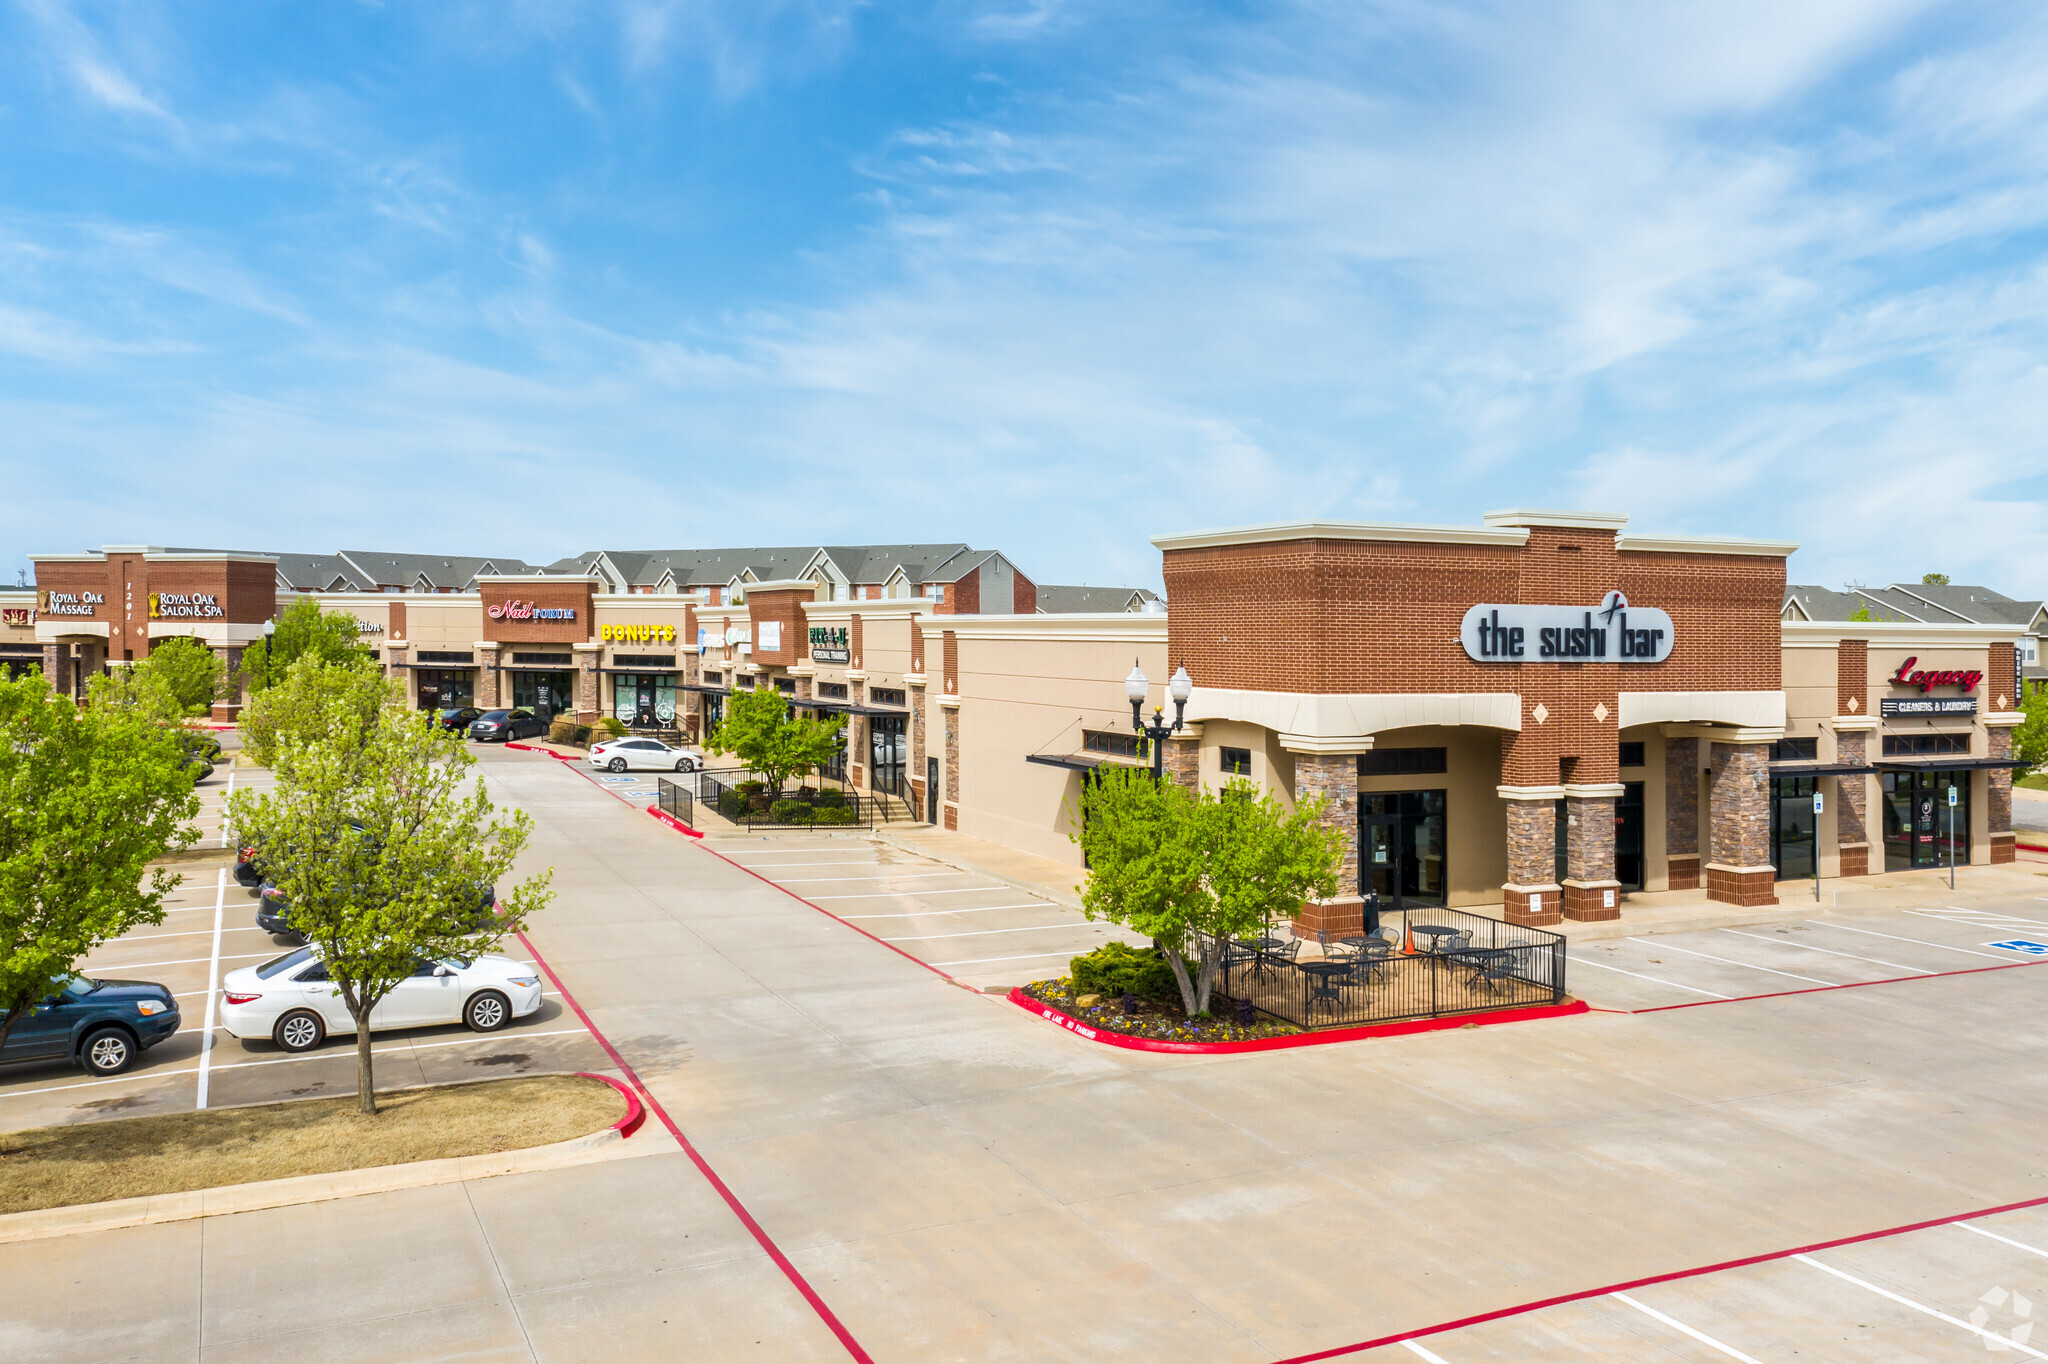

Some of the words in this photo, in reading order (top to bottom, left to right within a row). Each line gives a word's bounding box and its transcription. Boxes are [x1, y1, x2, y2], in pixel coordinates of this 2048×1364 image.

[49, 590, 79, 603] ROYAL
[82, 591, 104, 604] OAK
[160, 592, 191, 605] ROYAL
[192, 592, 215, 605] OAK
[49, 602, 94, 615] MASSAGE
[160, 604, 193, 616] SALON
[194, 605, 204, 617] &
[204, 605, 223, 617] SPA
[488, 599, 534, 619] Nail
[533, 608, 574, 619] FORUM
[601, 624, 675, 642] DONUTS
[1478, 609, 1524, 657] the
[1540, 611, 1607, 657] sushi
[1620, 612, 1664, 657] bar
[1888, 656, 1984, 693] Legacy
[1898, 702, 1933, 712] CLEANERS
[1934, 702, 1941, 711] &
[1941, 701, 1973, 711] LAUNDRY
[1066, 1021, 1075, 1030] NO
[1074, 1024, 1097, 1039] PARKING
